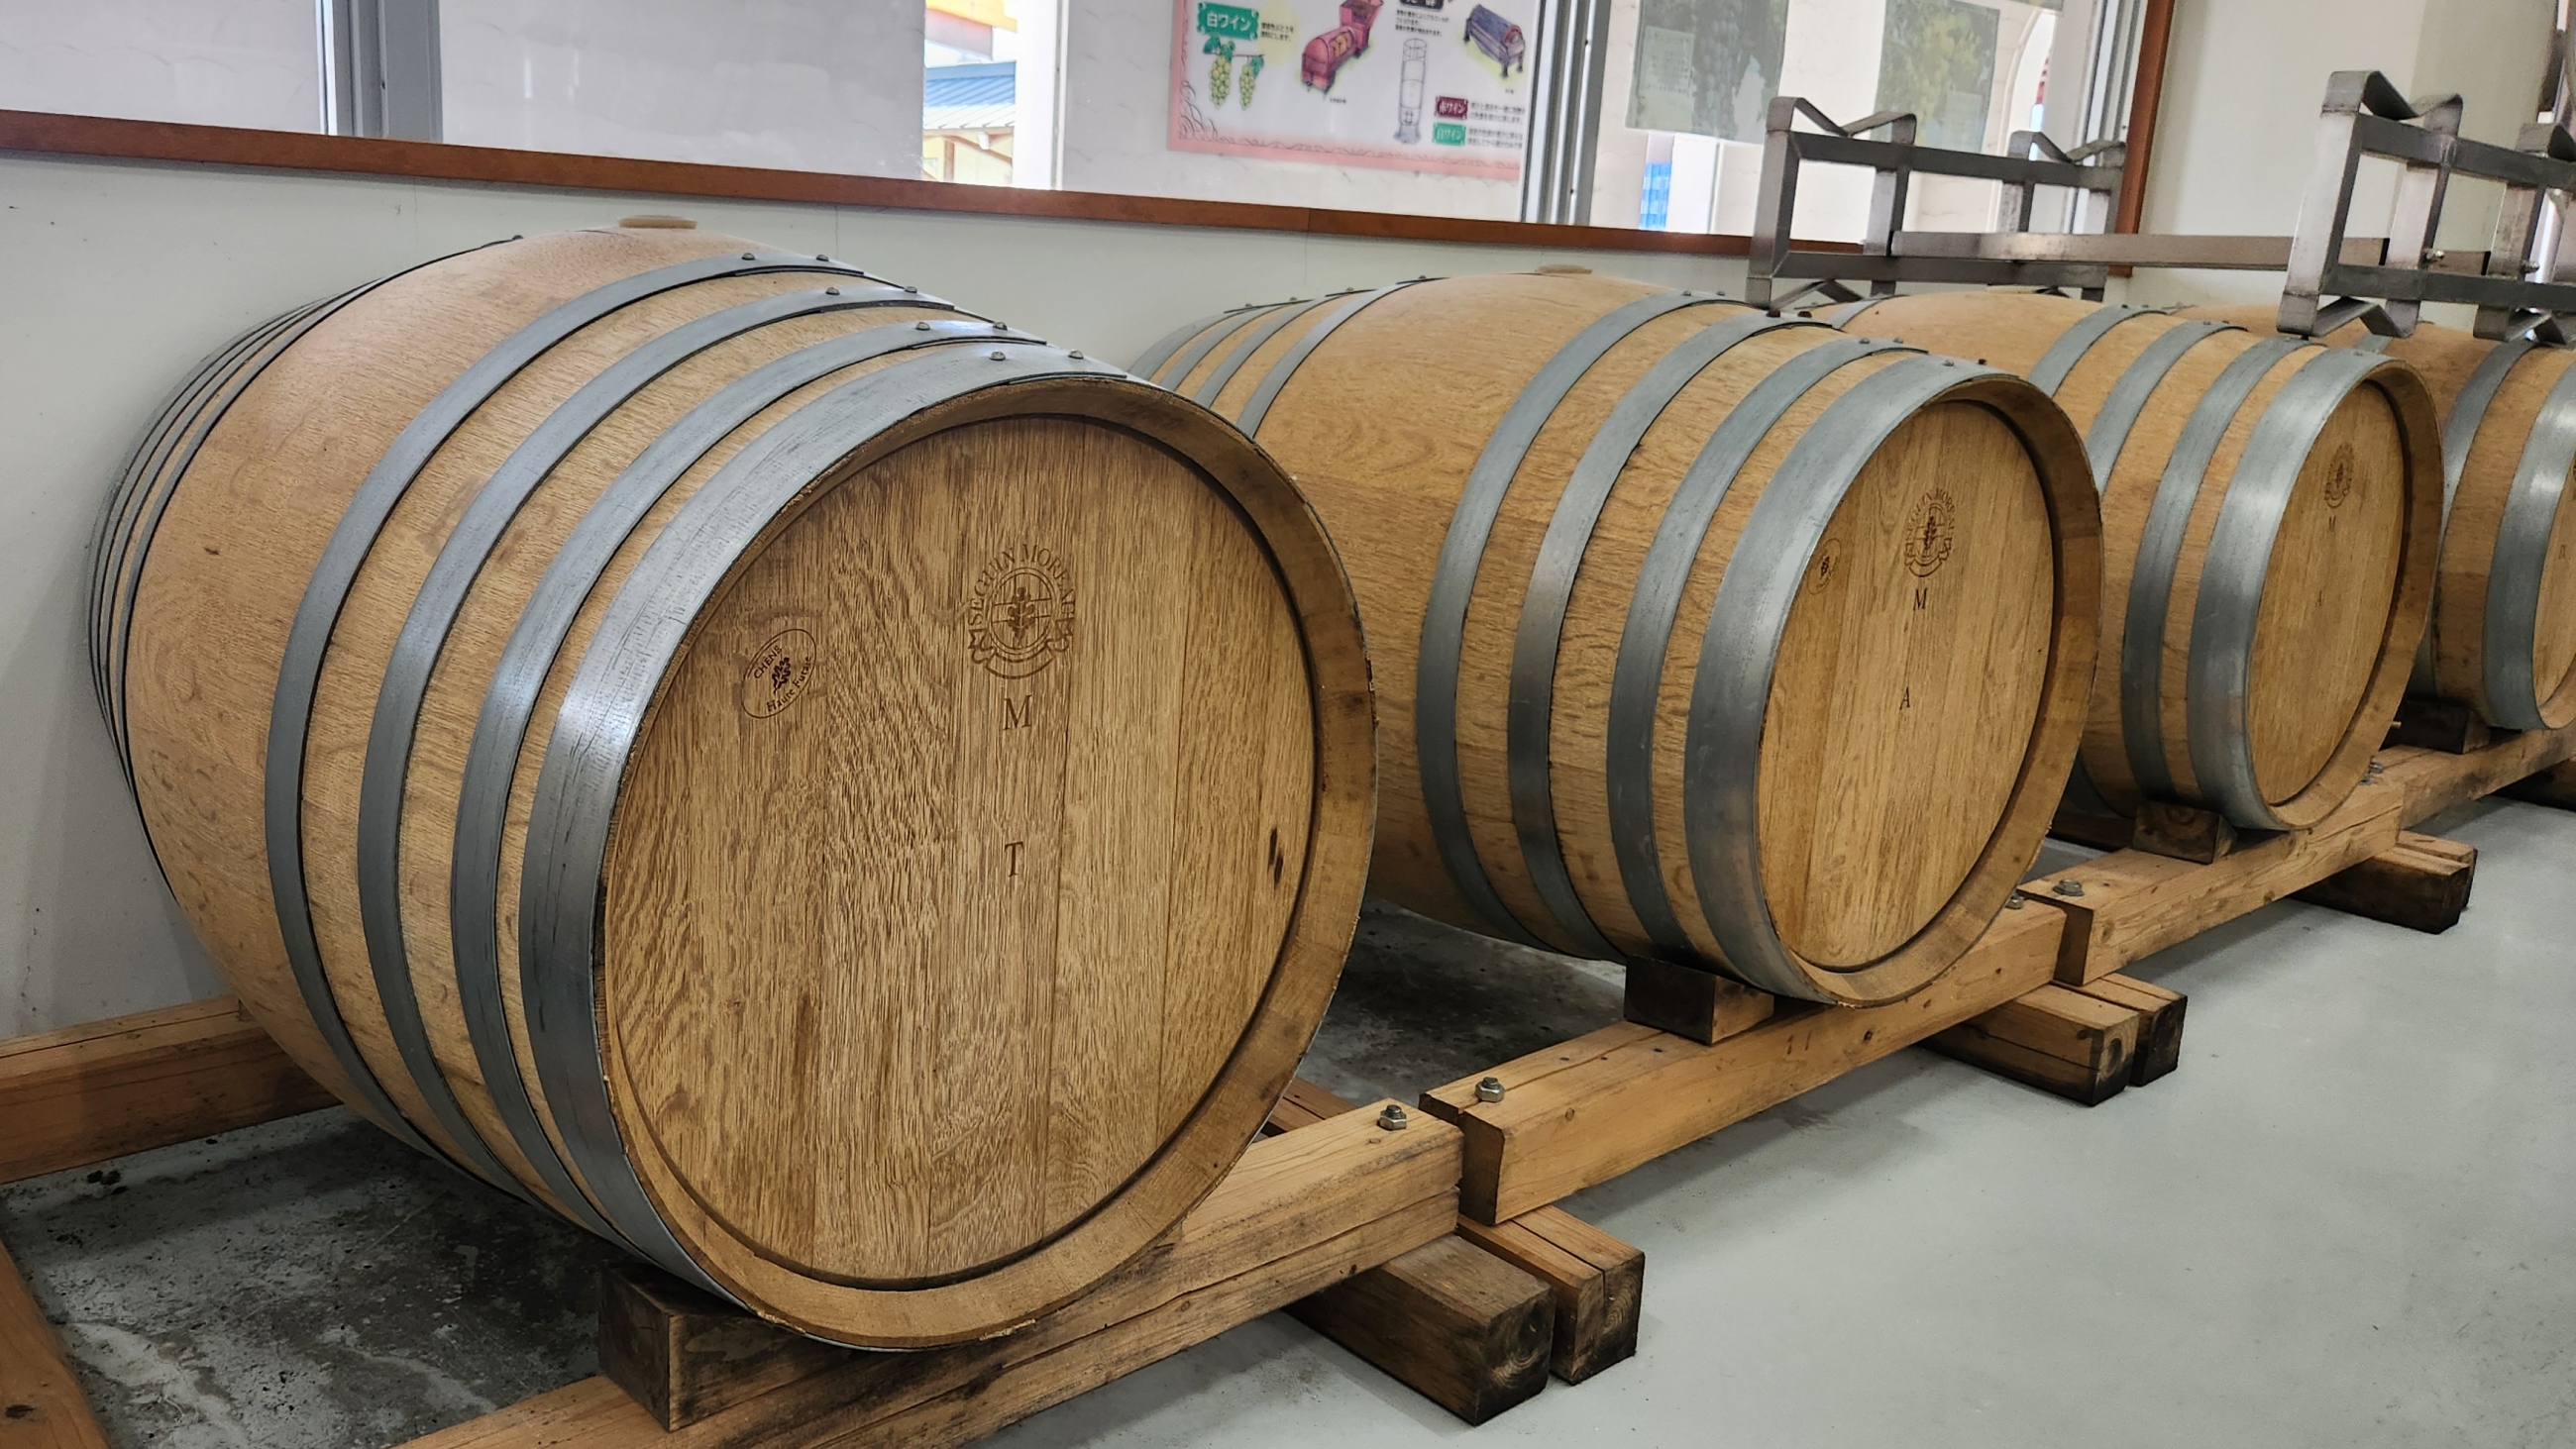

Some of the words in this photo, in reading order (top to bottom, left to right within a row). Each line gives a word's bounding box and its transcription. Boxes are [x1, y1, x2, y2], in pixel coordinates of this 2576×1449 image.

[1206, 11, 1251, 32] 白ワイン
[967, 547, 1015, 626] SEGUIN
[1021, 544, 1076, 615] MOREAU
[1912, 588, 1928, 611] M
[1003, 694, 1032, 731] M
[1899, 687, 1910, 710] A
[1004, 842, 1024, 878] T
